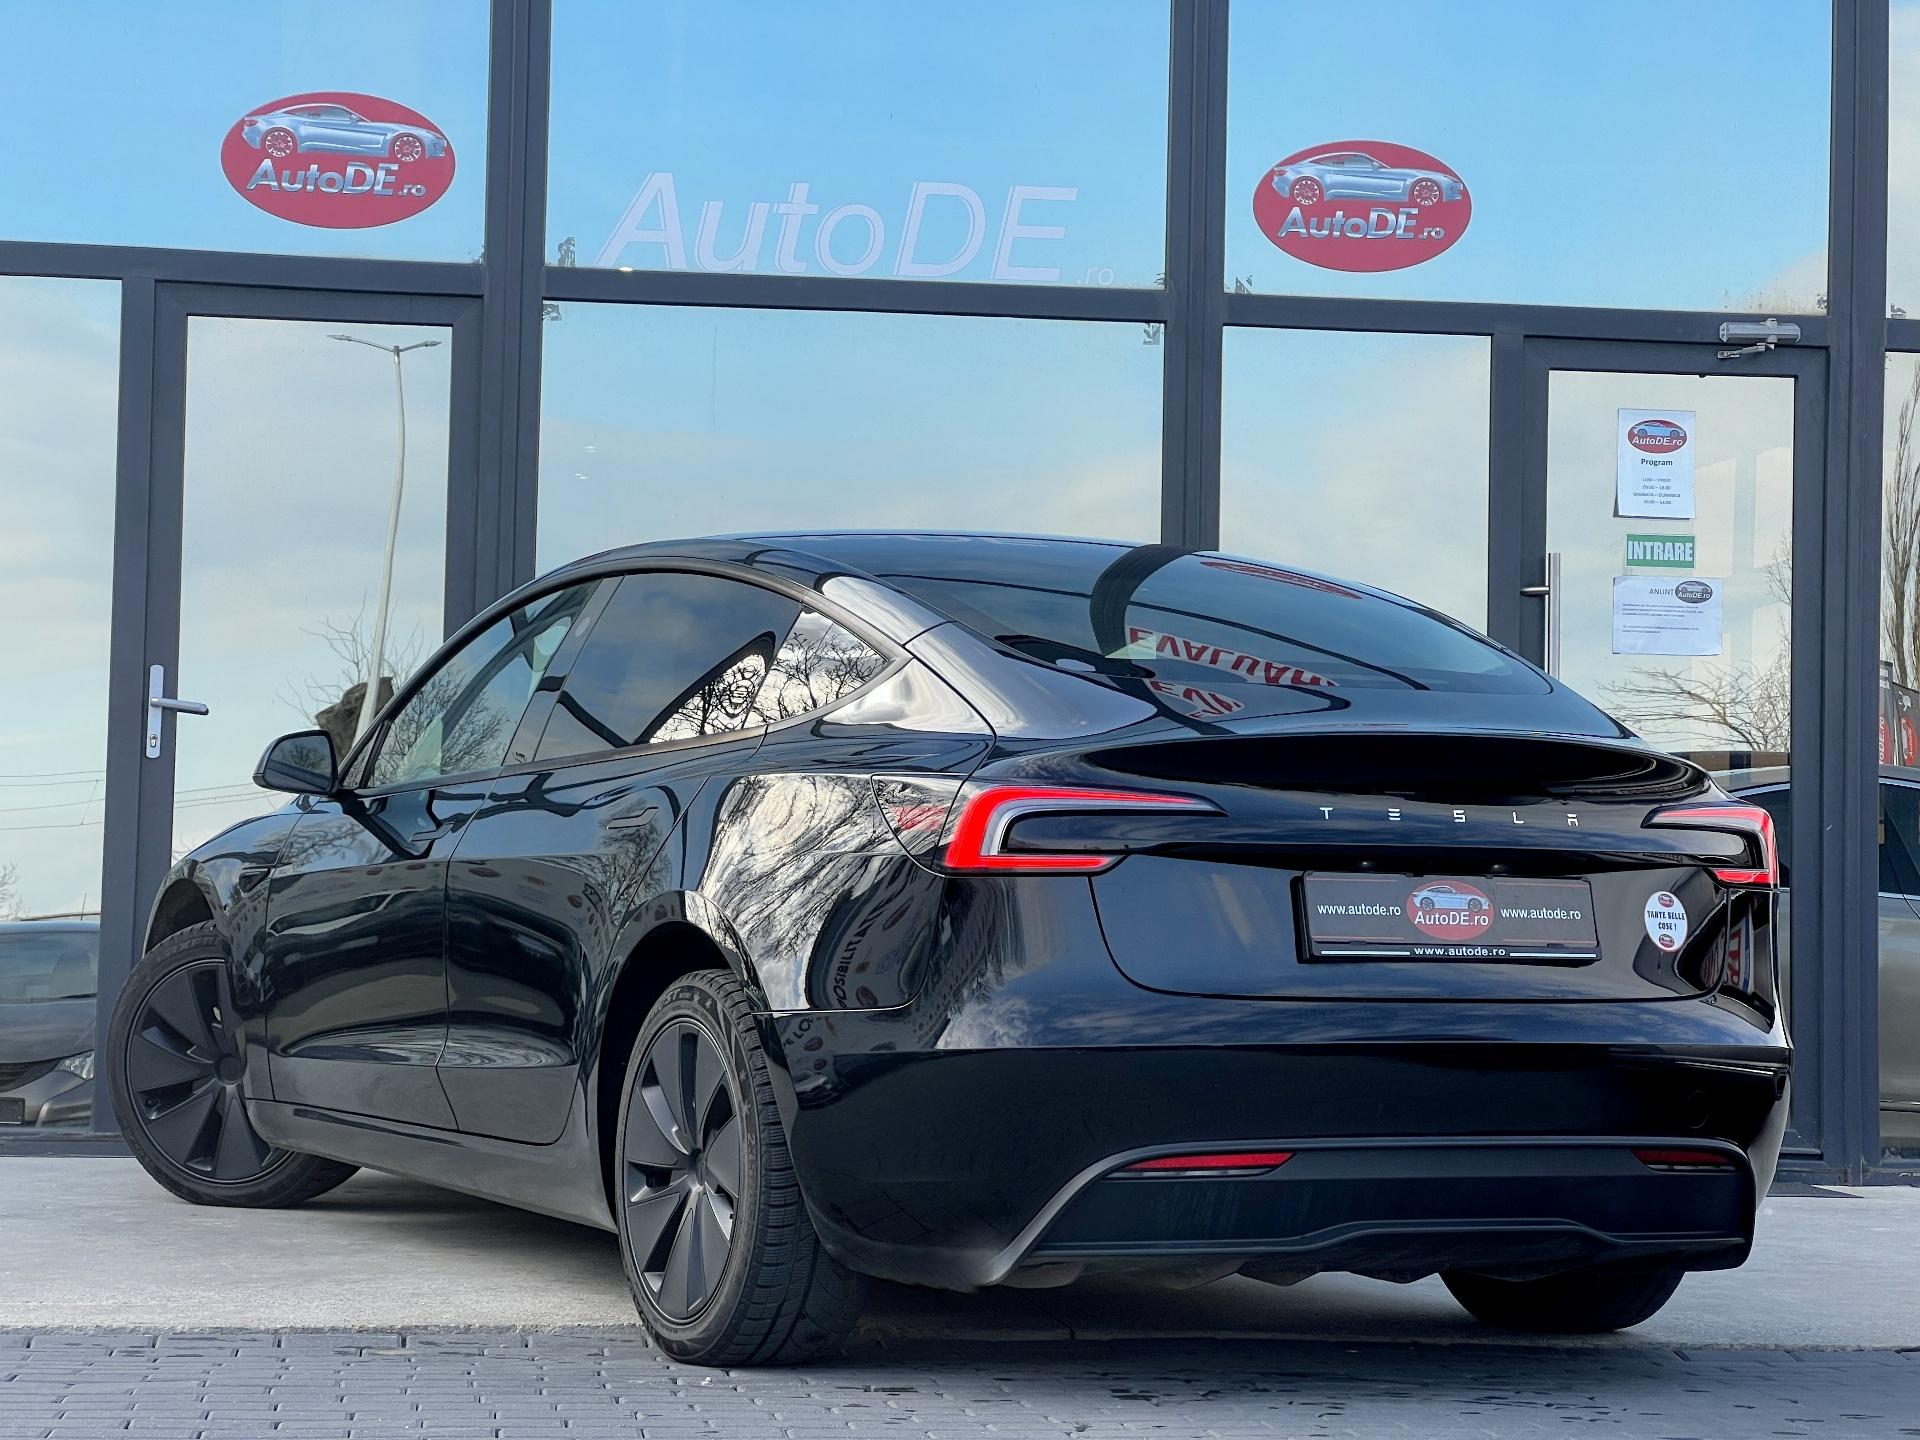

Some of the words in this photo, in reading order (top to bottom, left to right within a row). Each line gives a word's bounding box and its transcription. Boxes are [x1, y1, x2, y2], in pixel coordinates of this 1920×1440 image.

[1632, 437, 1683, 446] AutoDE.ro
[1641, 458, 1673, 467] Program
[1627, 541, 1694, 561] INTRARE
[1678, 591, 1711, 599] AutoDE.ro
[1319, 806, 1580, 827] TESLA
[1317, 903, 1401, 916] www.autode.ro
[1500, 908, 1582, 920] www.autode.ro
[1414, 911, 1489, 926] AutoDE.ro
[1647, 910, 1666, 919] TANTE
[1668, 911, 1685, 921] BELLE
[1658, 922, 1672, 930] COSE
[1413, 946, 1506, 957] www.autode.ro
